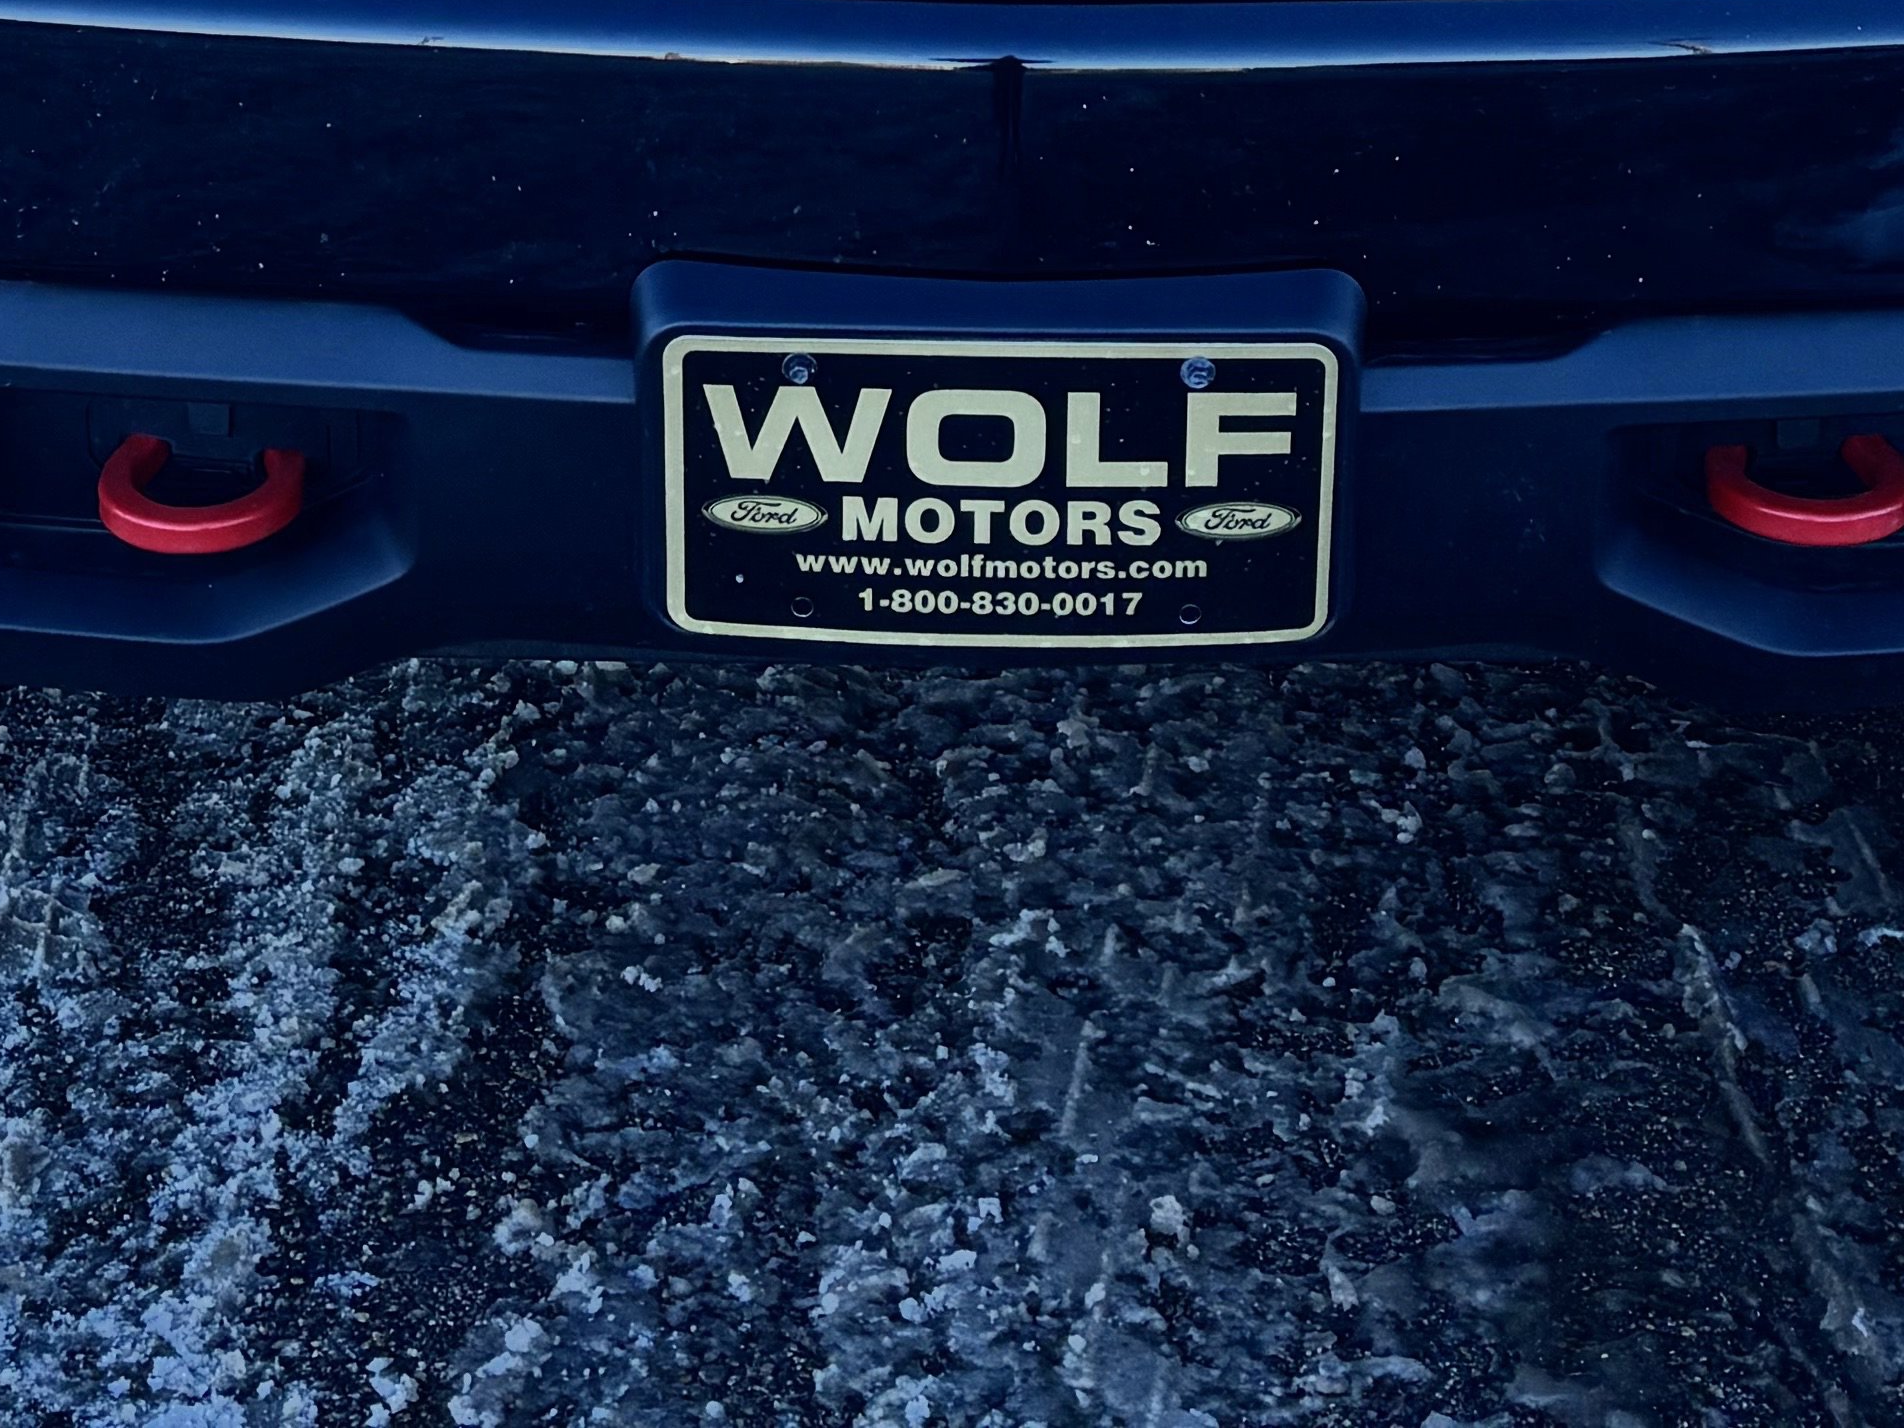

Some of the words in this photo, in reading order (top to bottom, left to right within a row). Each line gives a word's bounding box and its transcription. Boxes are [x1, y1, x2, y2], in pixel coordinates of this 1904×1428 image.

[702, 383, 1297, 488] WOLF
[842, 495, 1162, 546] MOTORS
[796, 553, 1208, 580] www.wolfmotors.com
[858, 588, 1143, 617] 1-800-830-0017
